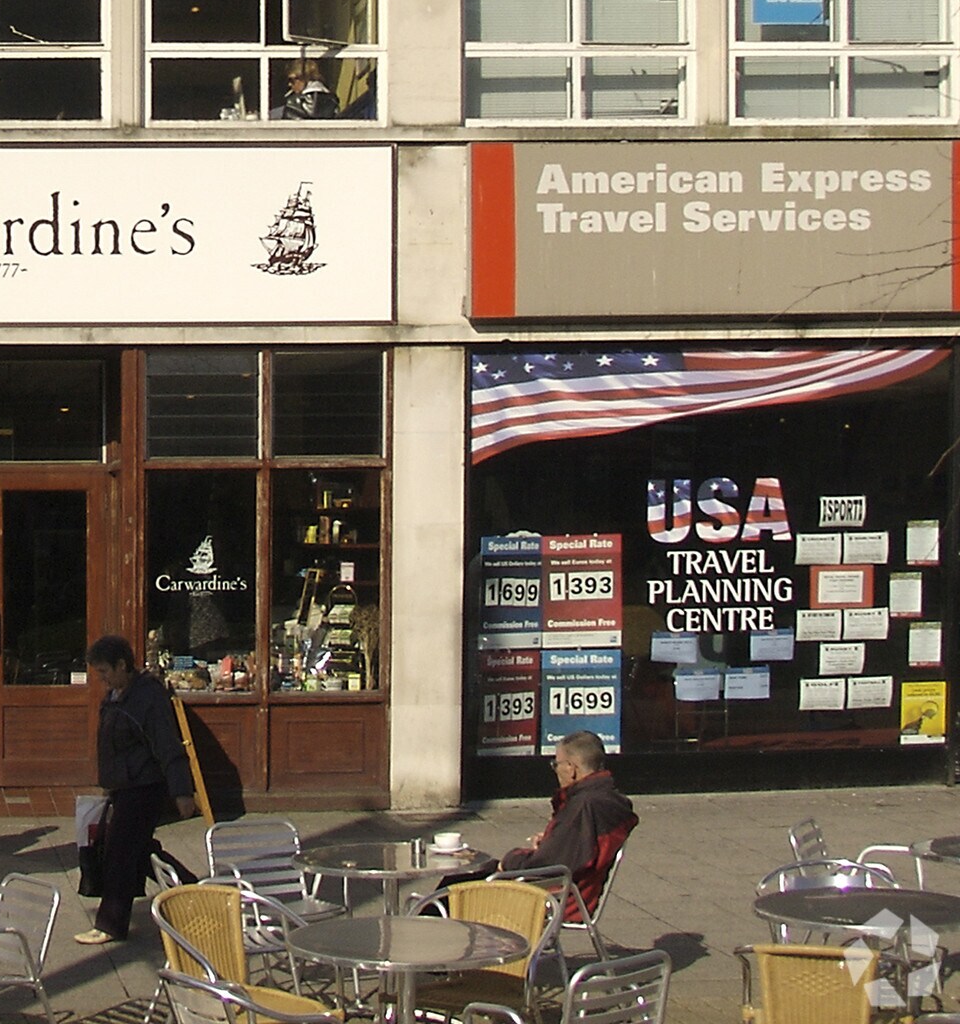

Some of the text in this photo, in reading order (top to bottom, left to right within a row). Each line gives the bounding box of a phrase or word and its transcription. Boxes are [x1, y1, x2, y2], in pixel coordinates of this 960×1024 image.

[537, 162, 932, 199] American Express
[537, 201, 871, 233] Travel Services
[647, 477, 792, 543] USA
[488, 541, 539, 552] Special Rate
[549, 539, 613, 553] Special Rate
[666, 549, 775, 575] TRAVEL
[155, 574, 247, 591] Carwardine's
[553, 577, 612, 596] 1.393
[646, 578, 793, 604] PLANNING
[547, 618, 616, 628] Commission Free
[666, 607, 774, 632] CENTRE
[550, 655, 614, 666] Special Rate
[553, 692, 613, 710] 1.699
